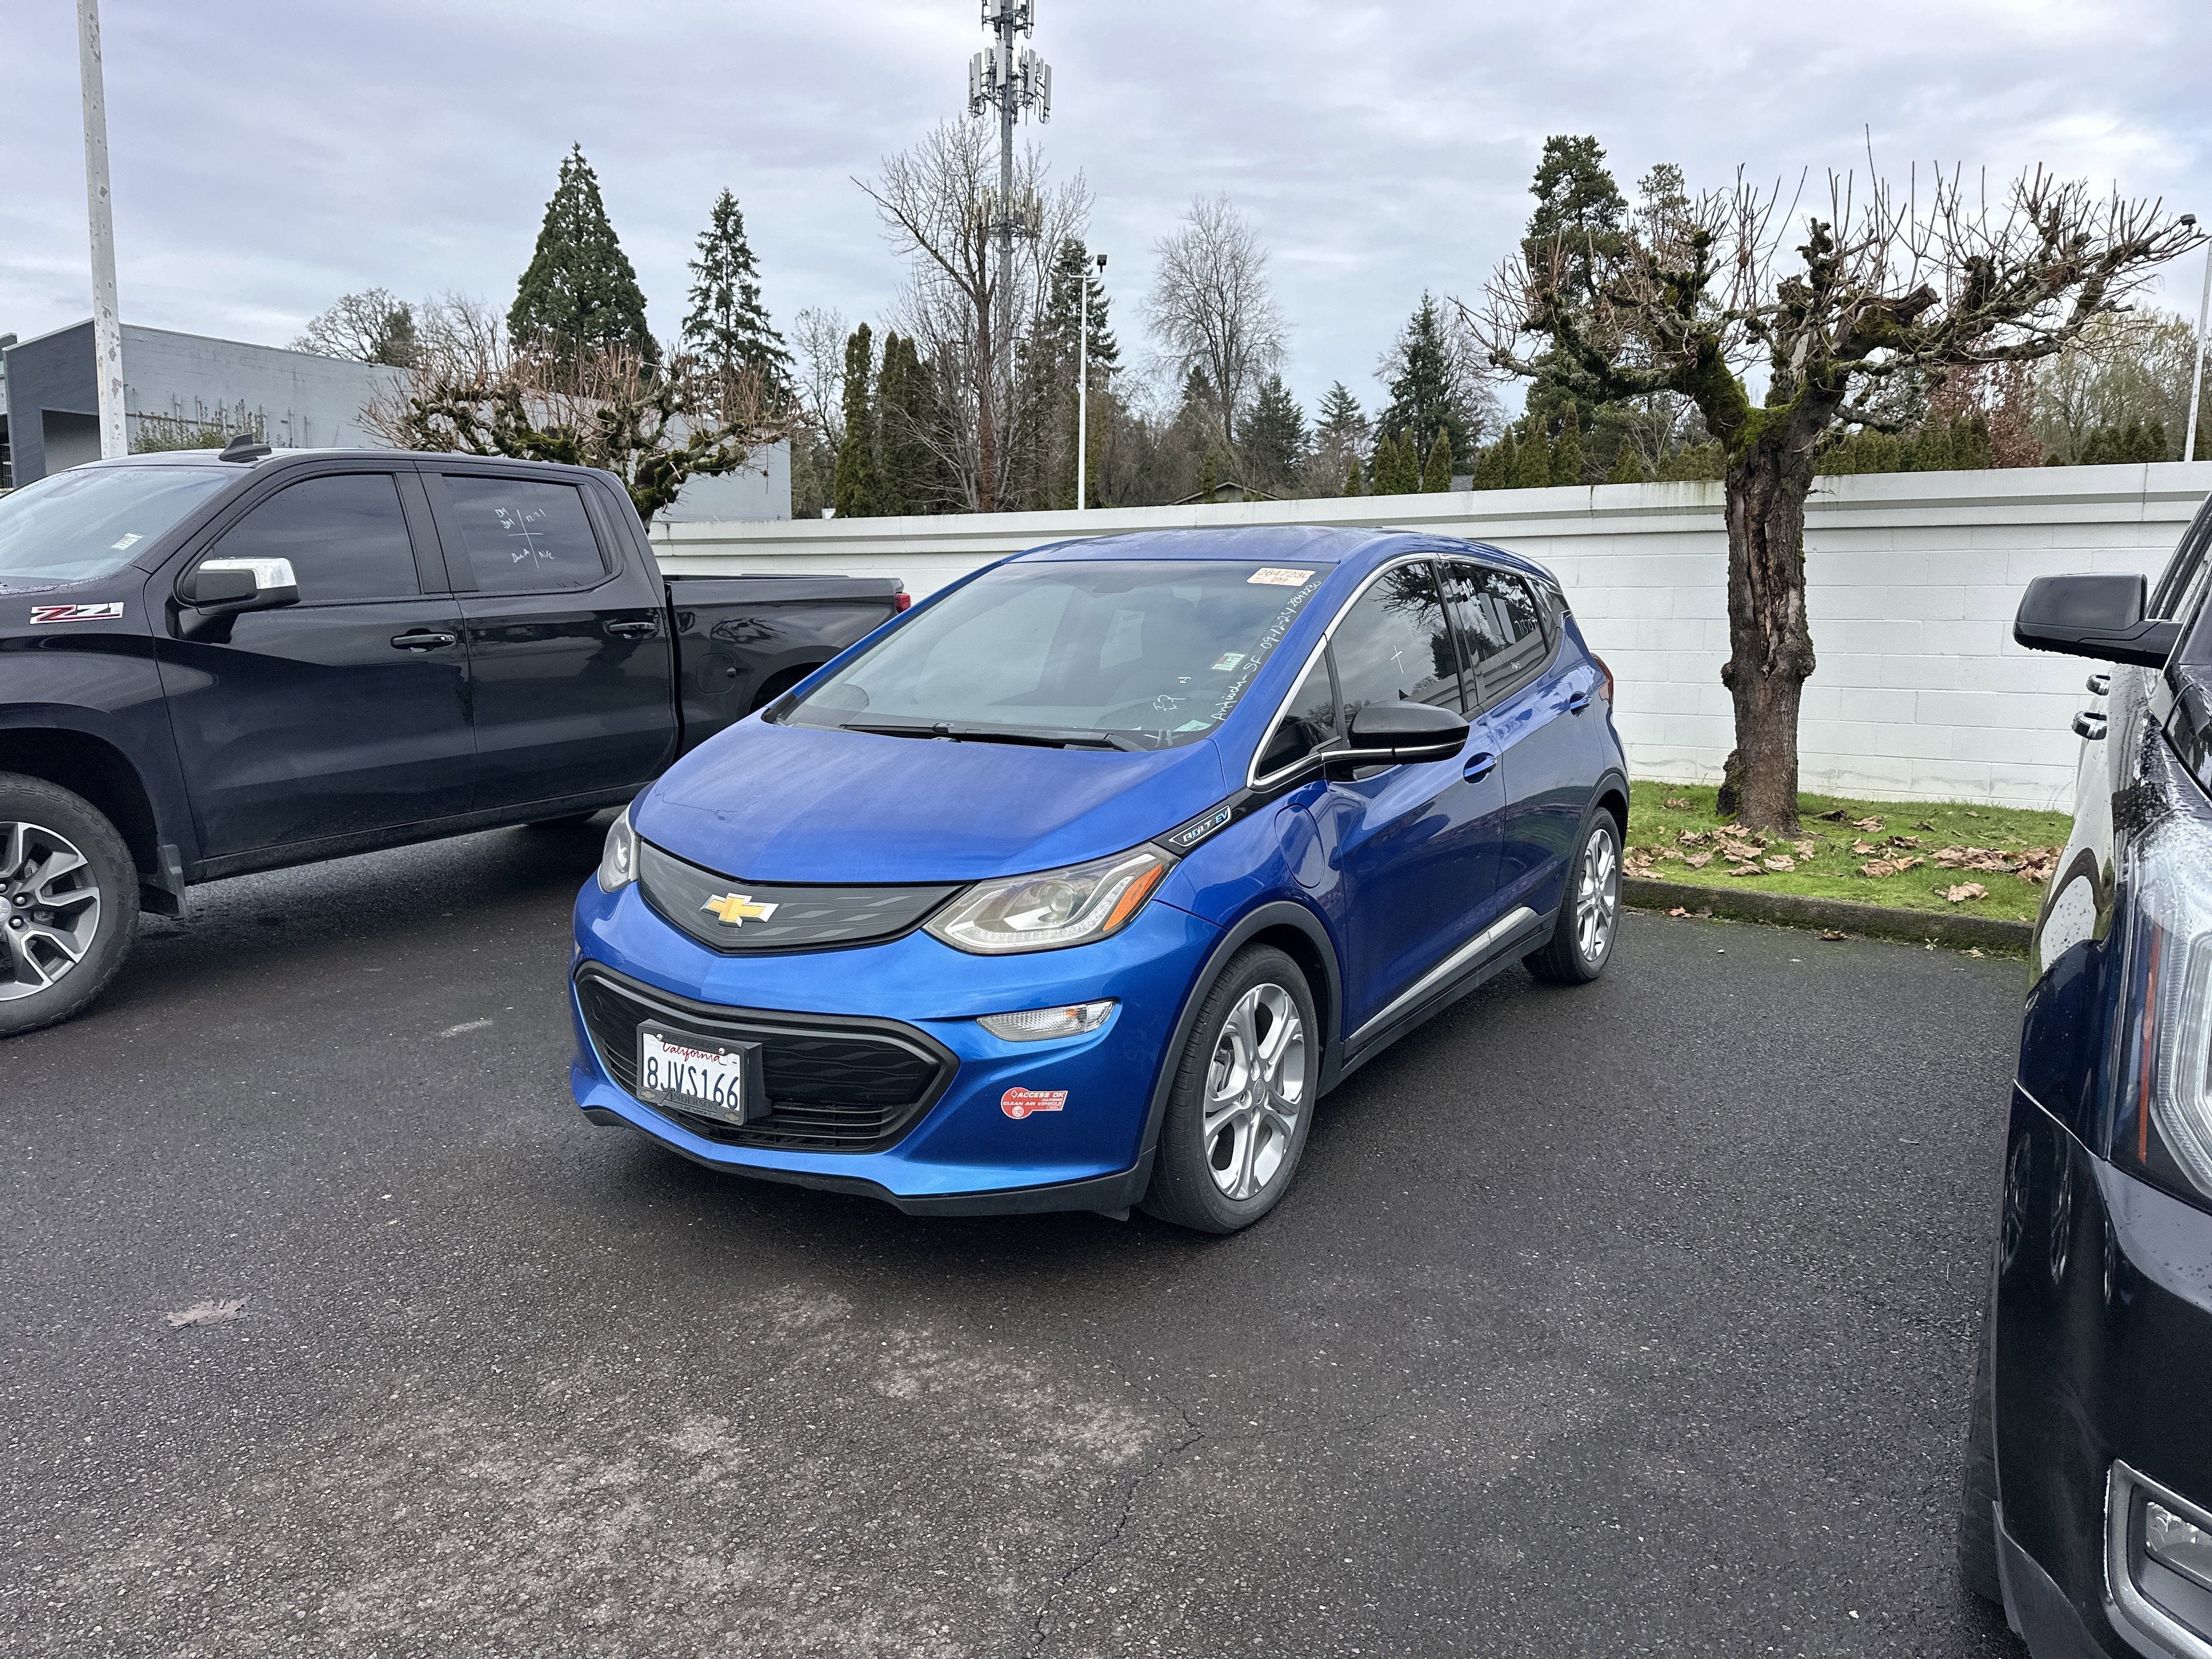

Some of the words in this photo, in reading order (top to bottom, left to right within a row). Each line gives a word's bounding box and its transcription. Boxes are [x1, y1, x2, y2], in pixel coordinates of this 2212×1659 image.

[30, 602, 124, 624] Z71
[1183, 820, 1212, 843] BOLT
[1215, 810, 1228, 824] EV
[662, 1042, 727, 1066] California
[647, 1056, 739, 1110] 8JVS166
[660, 1088, 719, 1111] ANDERSON
